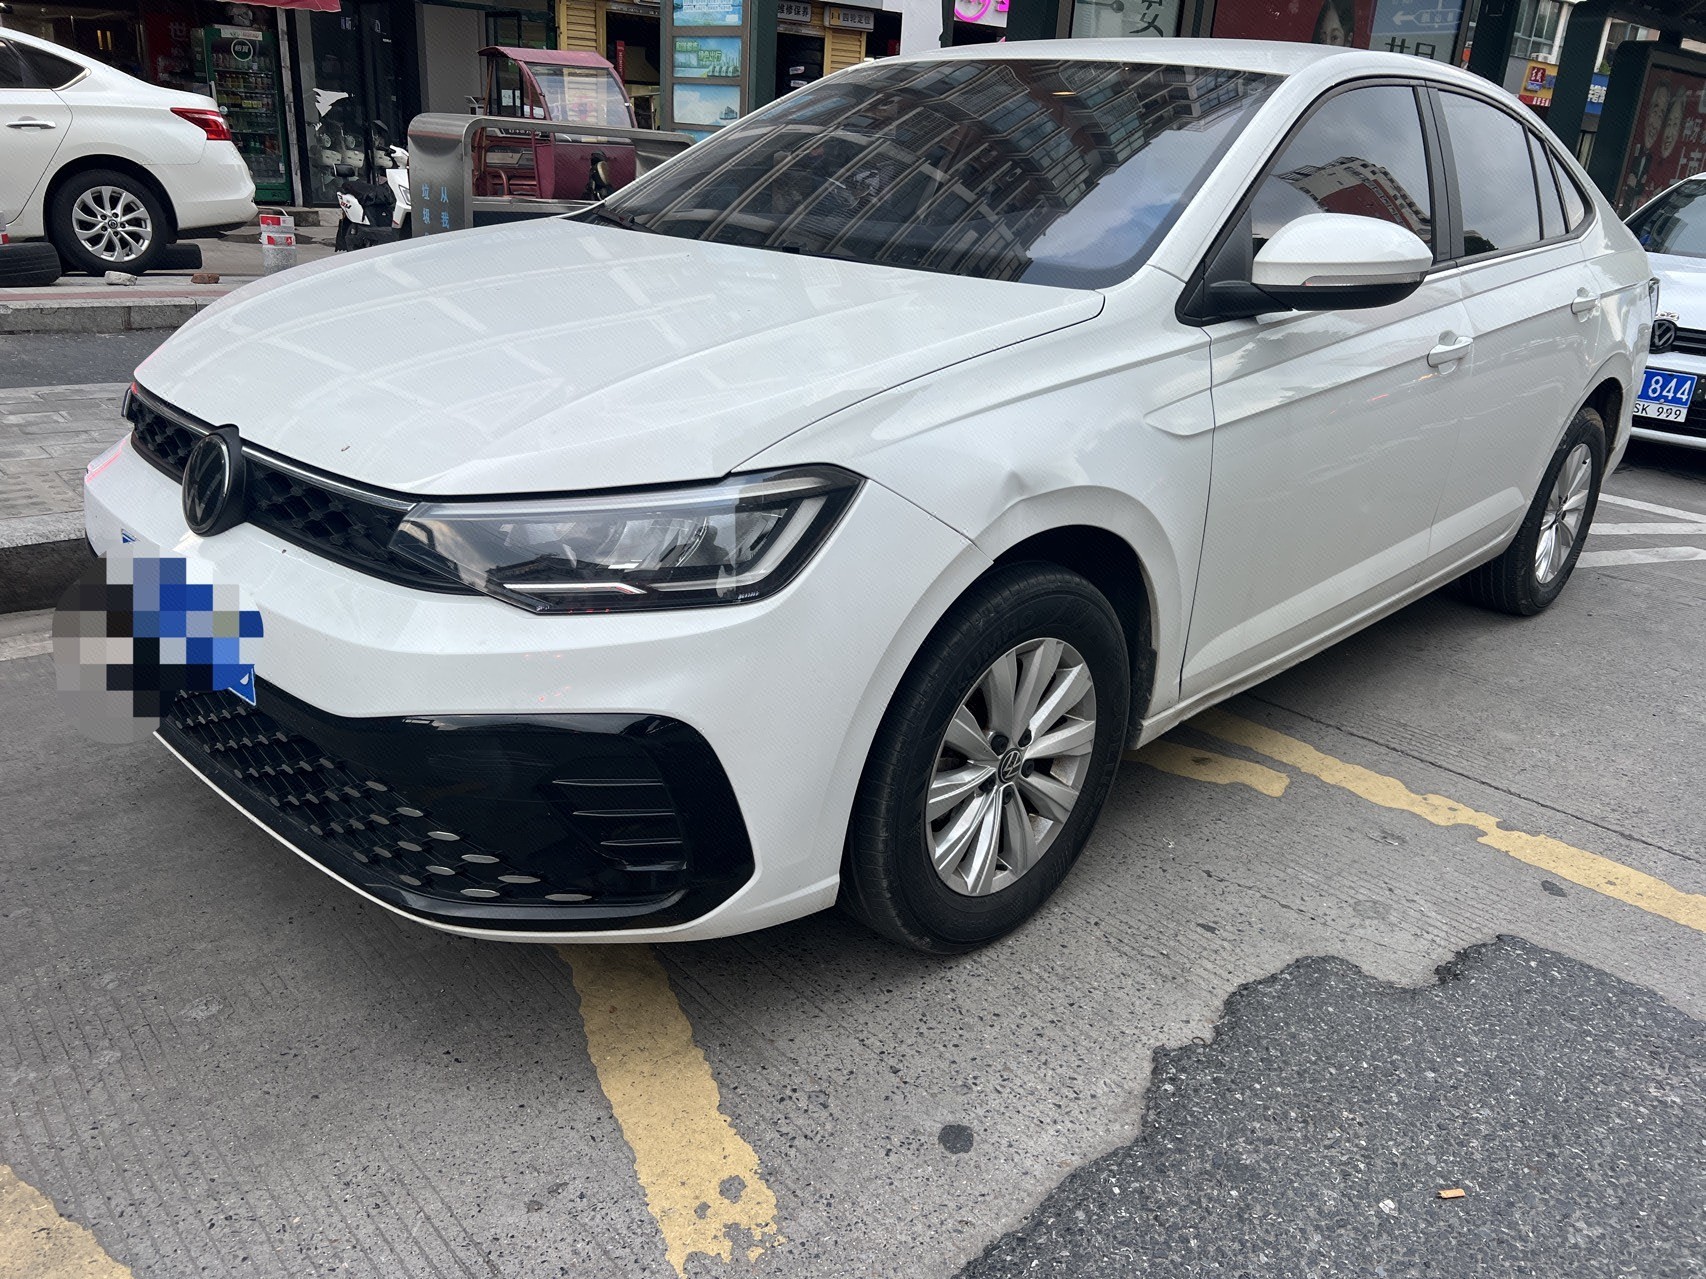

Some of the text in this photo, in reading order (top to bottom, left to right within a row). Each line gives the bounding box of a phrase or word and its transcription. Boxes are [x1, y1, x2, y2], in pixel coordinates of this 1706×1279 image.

[842, 12, 871, 25] 四轮定位
[1656, 406, 1682, 420] 999
